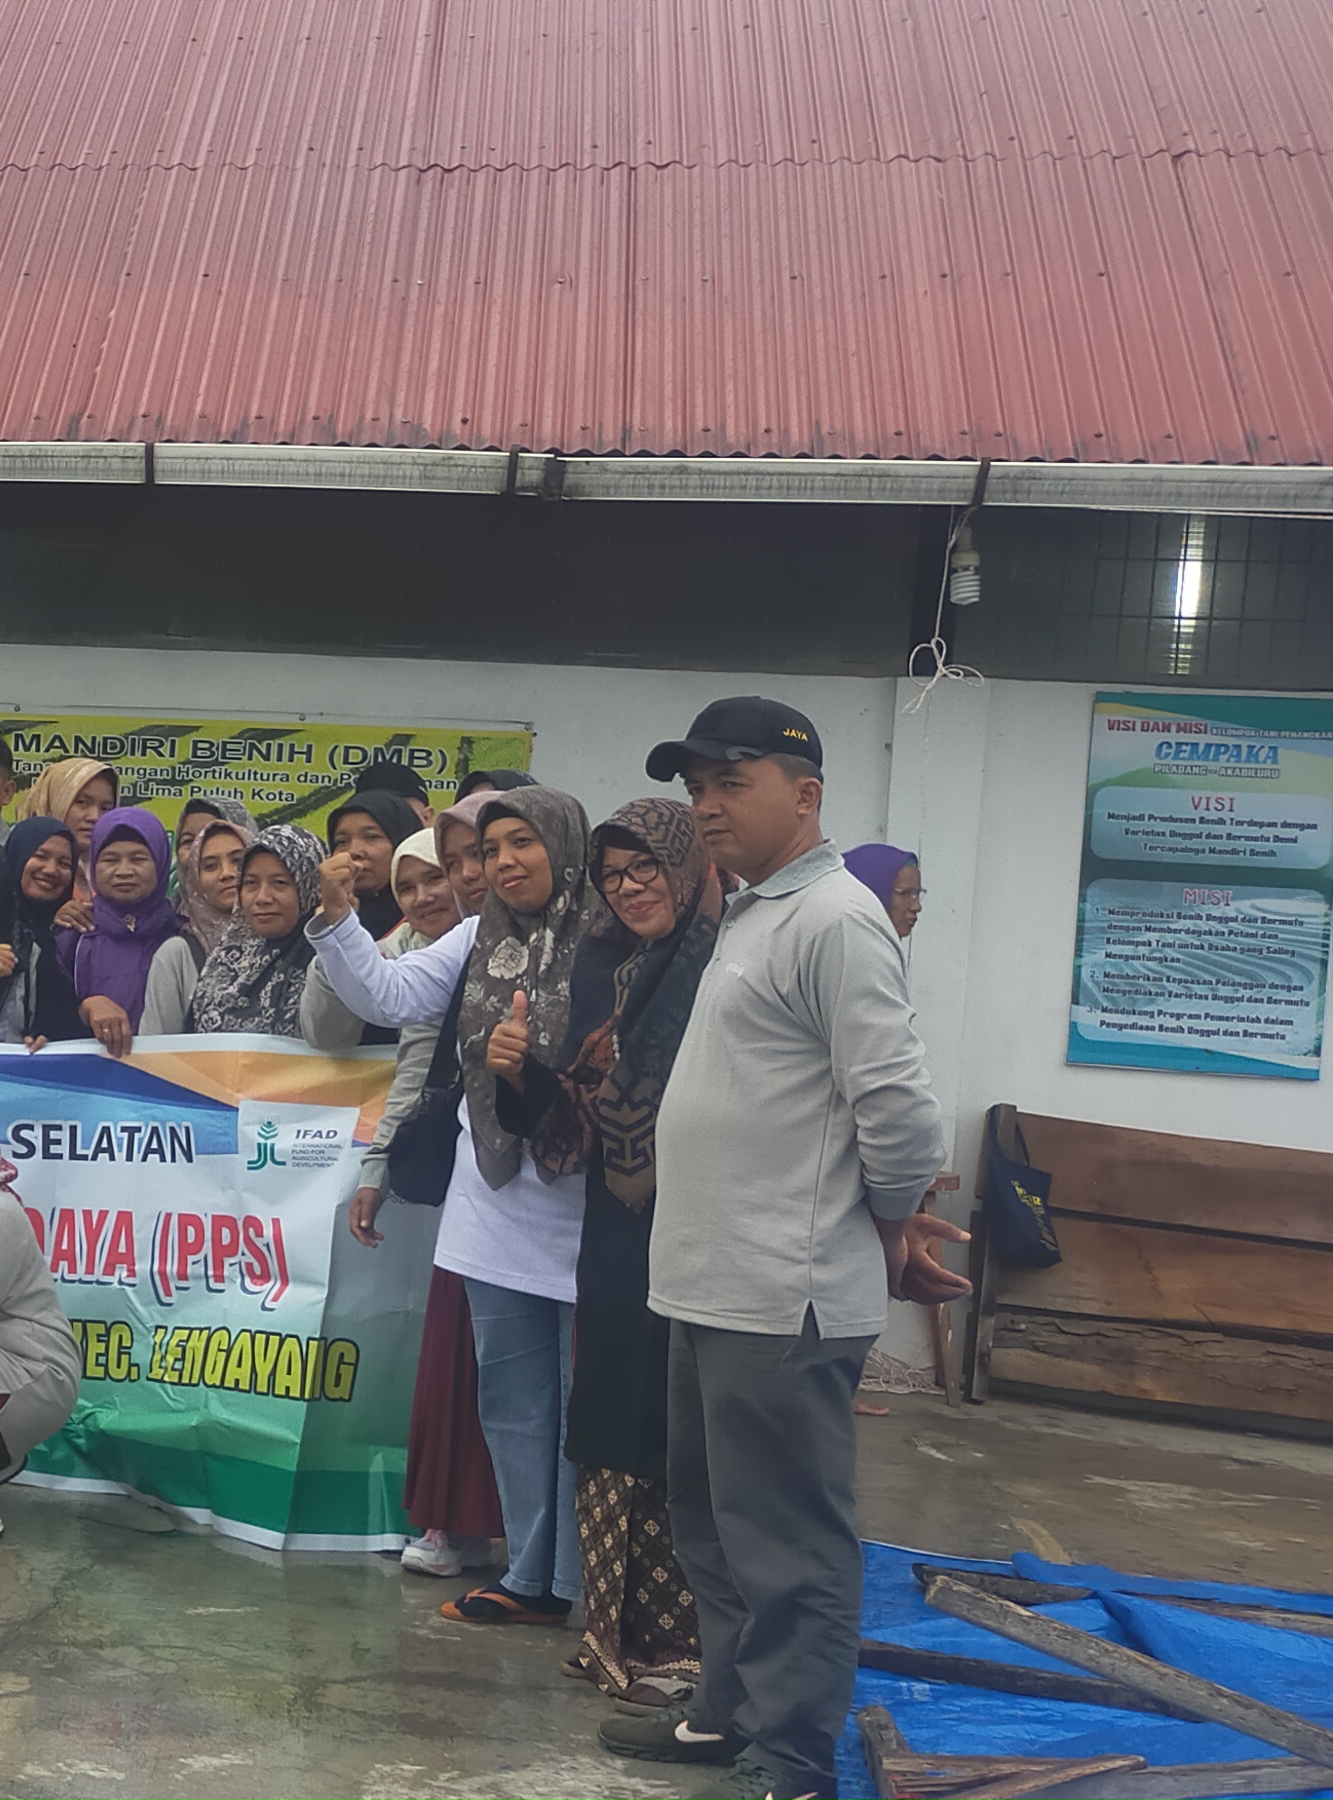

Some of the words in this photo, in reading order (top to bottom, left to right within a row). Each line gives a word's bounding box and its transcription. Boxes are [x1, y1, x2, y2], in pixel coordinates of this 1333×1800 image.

[783, 728, 808, 742] JAYA
[1107, 719, 1135, 732] VISI
[1140, 720, 1171, 733] DAN
[1176, 722, 1208, 734] MISI
[13, 732, 176, 758] MANDIRI
[190, 738, 313, 764] BENIH
[328, 744, 447, 775] (DMB)
[1155, 740, 1279, 765] CEMPAKA
[177, 766, 290, 783] Hortikultura
[297, 771, 331, 785] dan
[1154, 764, 1208, 776] PILADANG
[138, 783, 182, 798] Lima
[251, 788, 295, 802] Kota
[1191, 796, 1235, 812] VISI
[1107, 811, 1145, 823] Menjadi
[1148, 814, 1196, 824] Produsen
[1198, 816, 1226, 826] Benih
[1229, 818, 1277, 829] Terdepan
[1280, 820, 1318, 831] dengan
[1124, 828, 1166, 838] Varietas
[1169, 830, 1203, 841] Unggul
[1205, 832, 1223, 841] dan
[1226, 833, 1270, 843] Bermutu
[1208, 846, 1246, 856] Mandiri
[1249, 848, 1277, 858] Benih
[1183, 889, 1232, 906] MISI
[1108, 908, 1174, 921] Memproduksi
[1176, 911, 1203, 921] Benih
[1205, 913, 1238, 925] Unggul
[1240, 915, 1258, 924] dan
[1260, 916, 1304, 927] Bermutu
[1107, 922, 1142, 933] dengan
[1144, 924, 1225, 938] Memberdayakan
[1228, 929, 1258, 938] Petani
[1260, 931, 1278, 940] dan
[1106, 937, 1152, 948] Kelompok
[1155, 939, 1175, 948] Tani
[1177, 941, 1205, 951] untuk
[1239, 945, 1263, 955] yang
[1265, 946, 1296, 957] Saling
[1105, 951, 1181, 964] Menguntungkan
[1103, 971, 1163, 983] Memberikan
[1166, 976, 1213, 987] Kepuasan
[1215, 978, 1266, 990] Pelanggan
[1268, 981, 1304, 992] dengan
[1102, 986, 1165, 998] Menyediakan
[1168, 990, 1209, 1001] Varietas
[1211, 992, 1244, 1004] Unggul
[1246, 995, 1264, 1004] dan
[1266, 996, 1310, 1007] Bermutu
[1101, 1005, 1155, 1018] Mendukung
[1157, 1009, 1202, 1021] Program
[1204, 1013, 1261, 1024] Pemerintah
[1264, 1016, 1294, 1026] dalam
[1100, 1020, 1156, 1032] Penyediaan
[1158, 1024, 1185, 1034] Benih
[1187, 1026, 1220, 1037] Unggul
[1222, 1029, 1240, 1037] dan
[1242, 1030, 1286, 1041] Bermutu
[10, 1123, 194, 1163] SELATAN
[295, 1129, 338, 1139] IFAD
[150, 1210, 290, 1311] (PPS)
